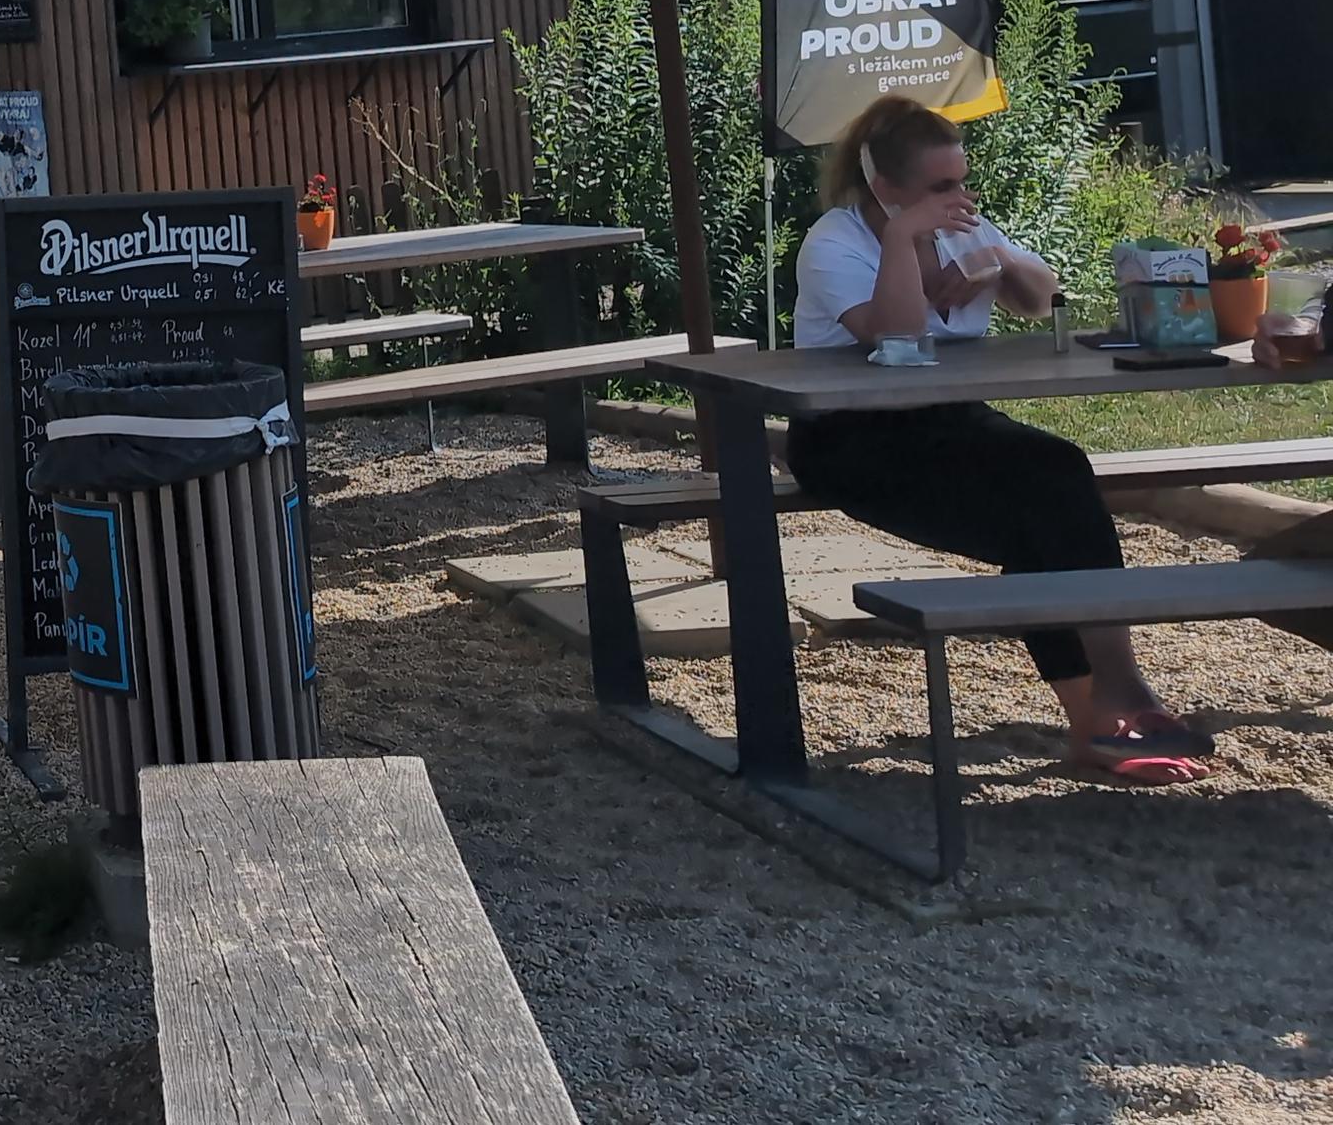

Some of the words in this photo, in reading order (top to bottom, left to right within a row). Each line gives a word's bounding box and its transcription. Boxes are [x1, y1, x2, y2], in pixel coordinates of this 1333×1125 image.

[800, 17, 943, 60] PROUD
[847, 61, 857, 75] s
[859, 52, 929, 75] ležákem
[932, 47, 965, 70] nové
[877, 67, 951, 93] generace
[55, 286, 115, 305] Pilsner
[120, 282, 181, 309] Urquell
[267, 279, 286, 296] Kč
[17, 324, 61, 351] Kozel
[162, 318, 205, 345] Proud
